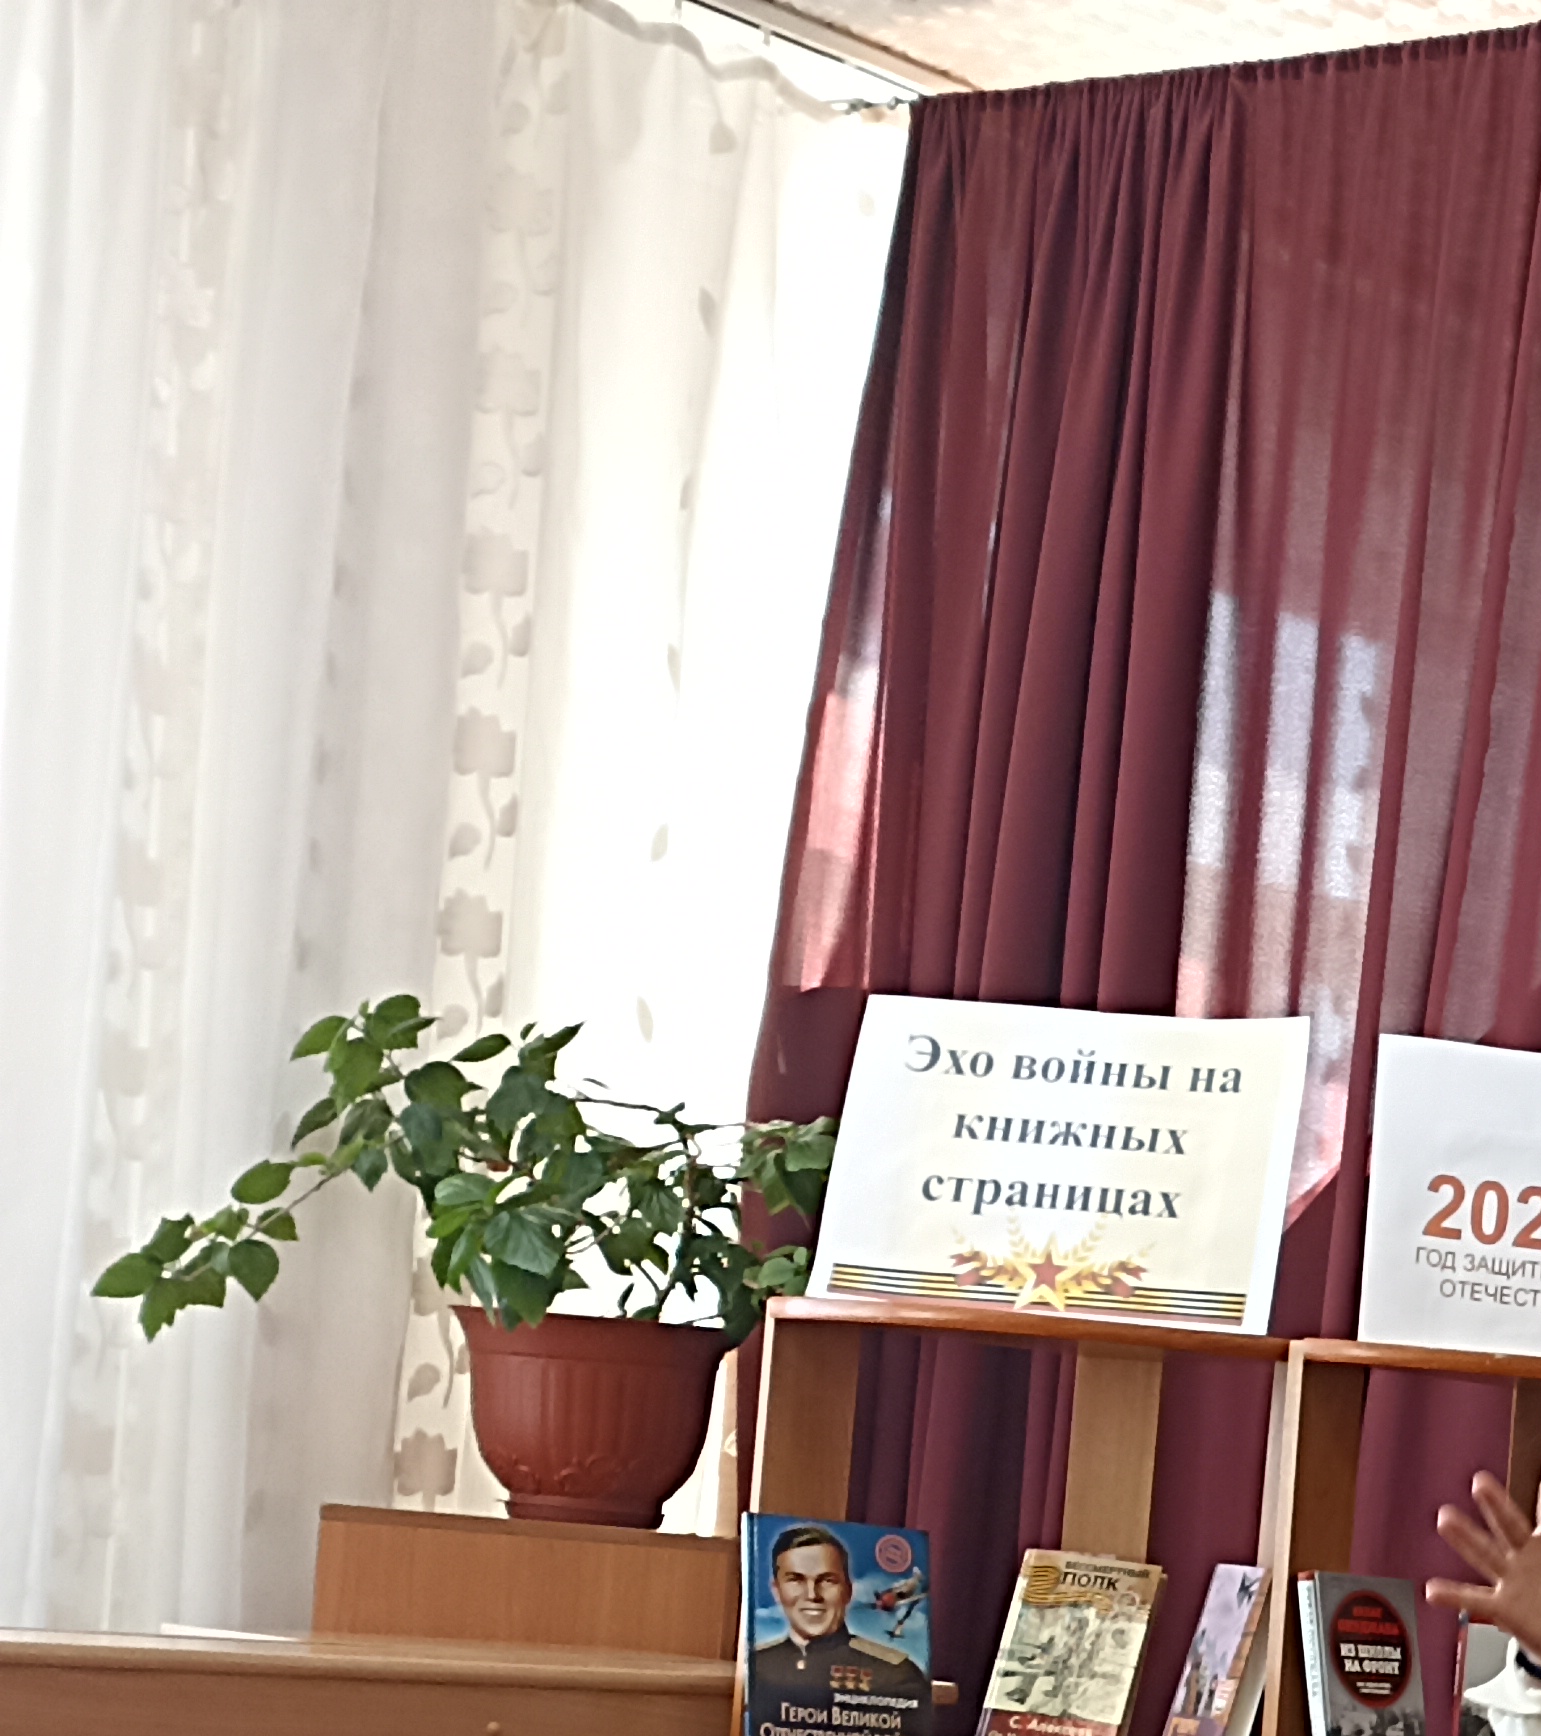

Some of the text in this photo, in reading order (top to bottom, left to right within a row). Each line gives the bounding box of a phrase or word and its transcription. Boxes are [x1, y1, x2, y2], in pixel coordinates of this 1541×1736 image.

[904, 1034, 1243, 1094] Эхо войны на
[953, 1112, 1188, 1156] книжных
[921, 1172, 1182, 1219] страницах
[1415, 1246, 1457, 1274] ГОД
[1060, 1571, 1121, 1592] ПОЛК
